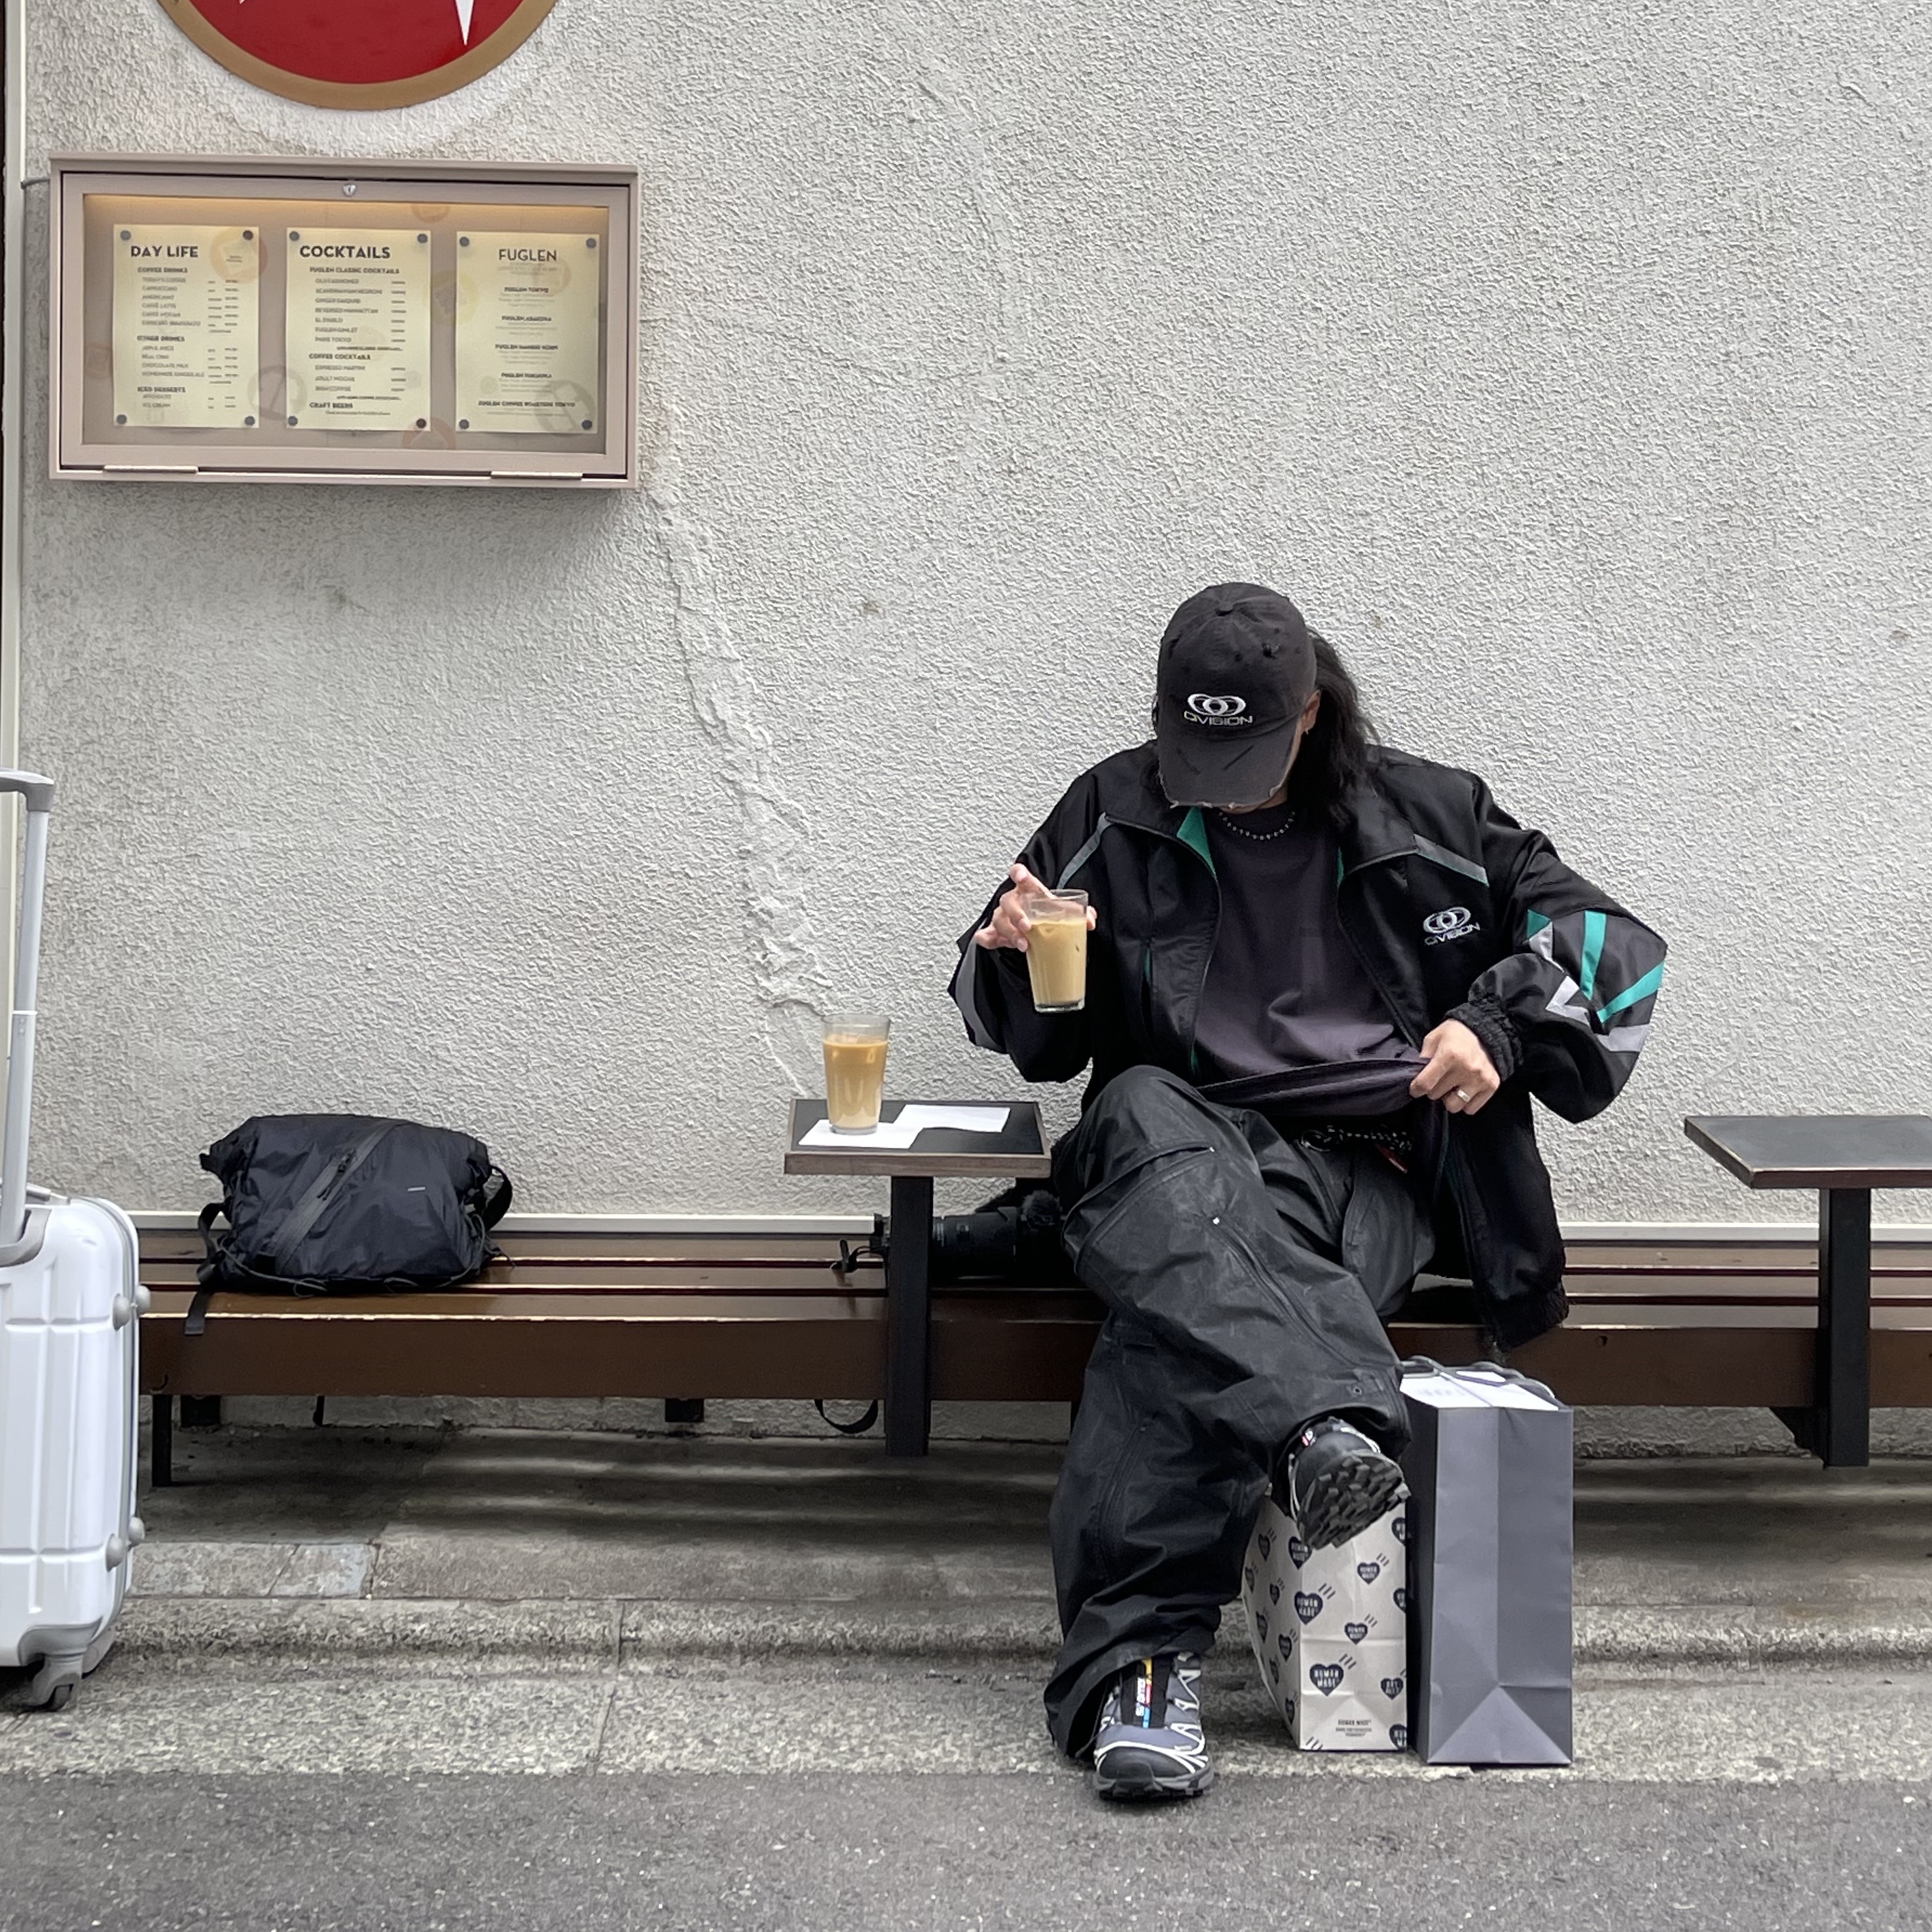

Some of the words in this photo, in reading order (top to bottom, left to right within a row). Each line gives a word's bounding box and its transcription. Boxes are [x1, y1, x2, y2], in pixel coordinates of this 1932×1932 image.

[131, 246, 162, 257] DAY
[167, 246, 198, 257] LIFE
[300, 246, 391, 259] COCKTAILS
[499, 248, 557, 262] FUGLEN
